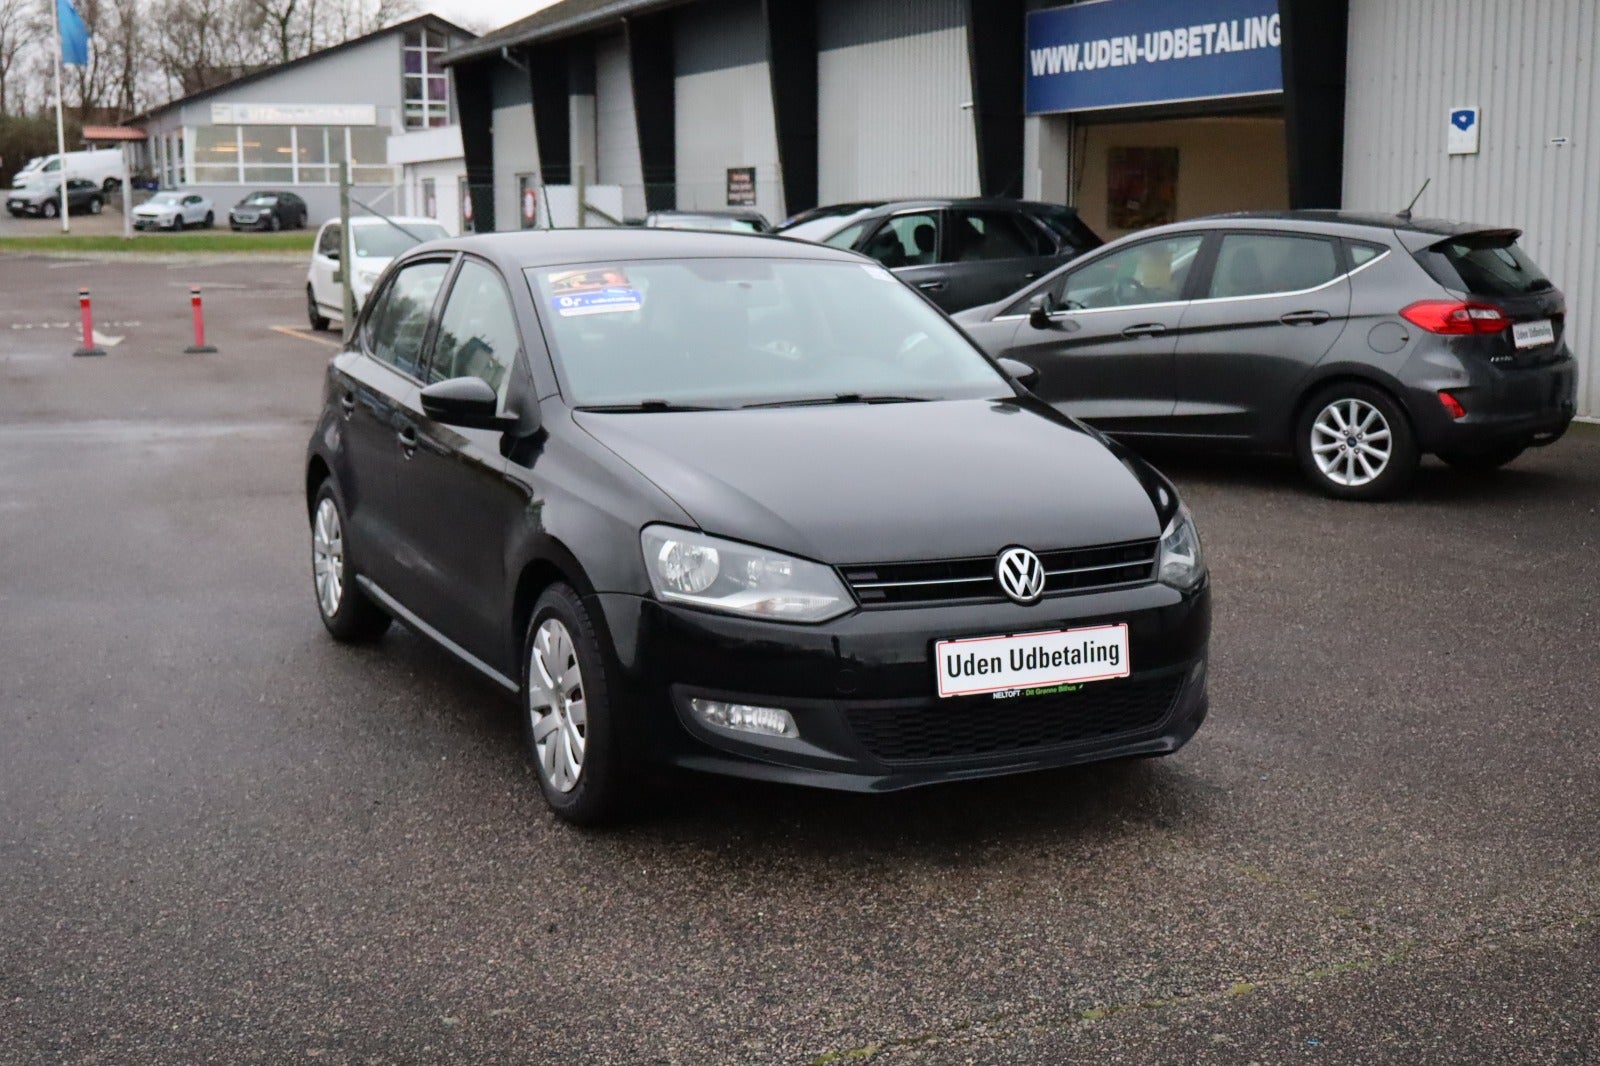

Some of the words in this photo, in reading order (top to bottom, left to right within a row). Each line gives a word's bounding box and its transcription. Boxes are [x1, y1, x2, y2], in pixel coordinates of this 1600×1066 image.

[1031, 13, 1280, 76] WWW.UDEN-UDBETALING
[947, 653, 1002, 678] Uden
[1010, 640, 1120, 672] Udbetaling
